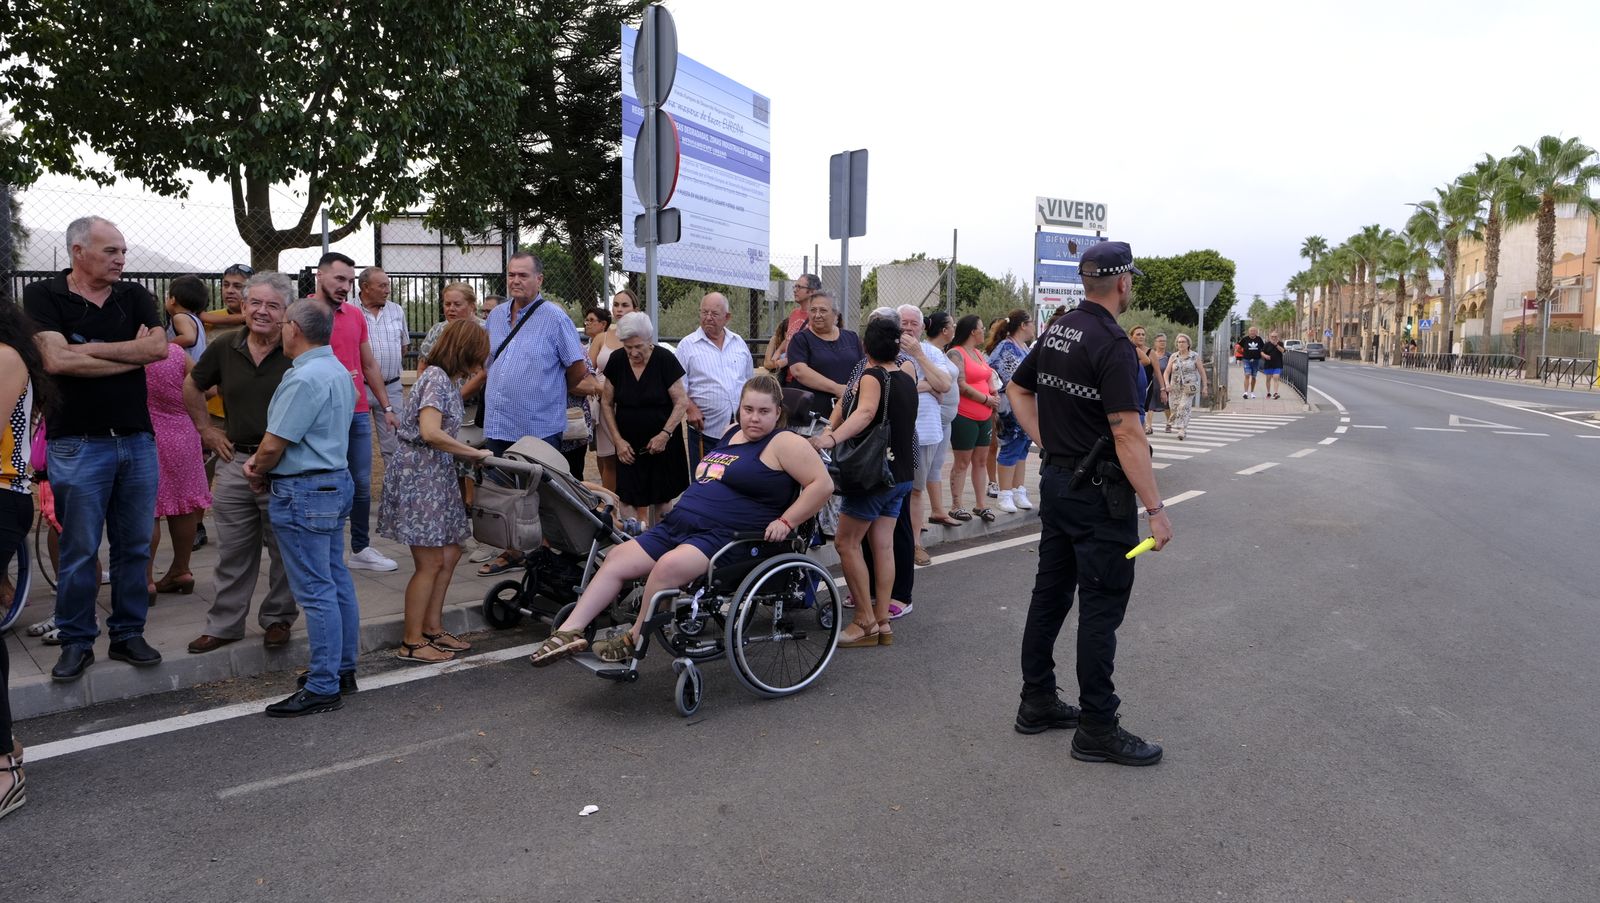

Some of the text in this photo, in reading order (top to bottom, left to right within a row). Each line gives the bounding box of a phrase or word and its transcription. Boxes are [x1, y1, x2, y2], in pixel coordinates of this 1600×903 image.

[699, 108, 705, 121] de
[722, 117, 743, 137] EUROPA
[1047, 199, 1105, 222] VIVERO
